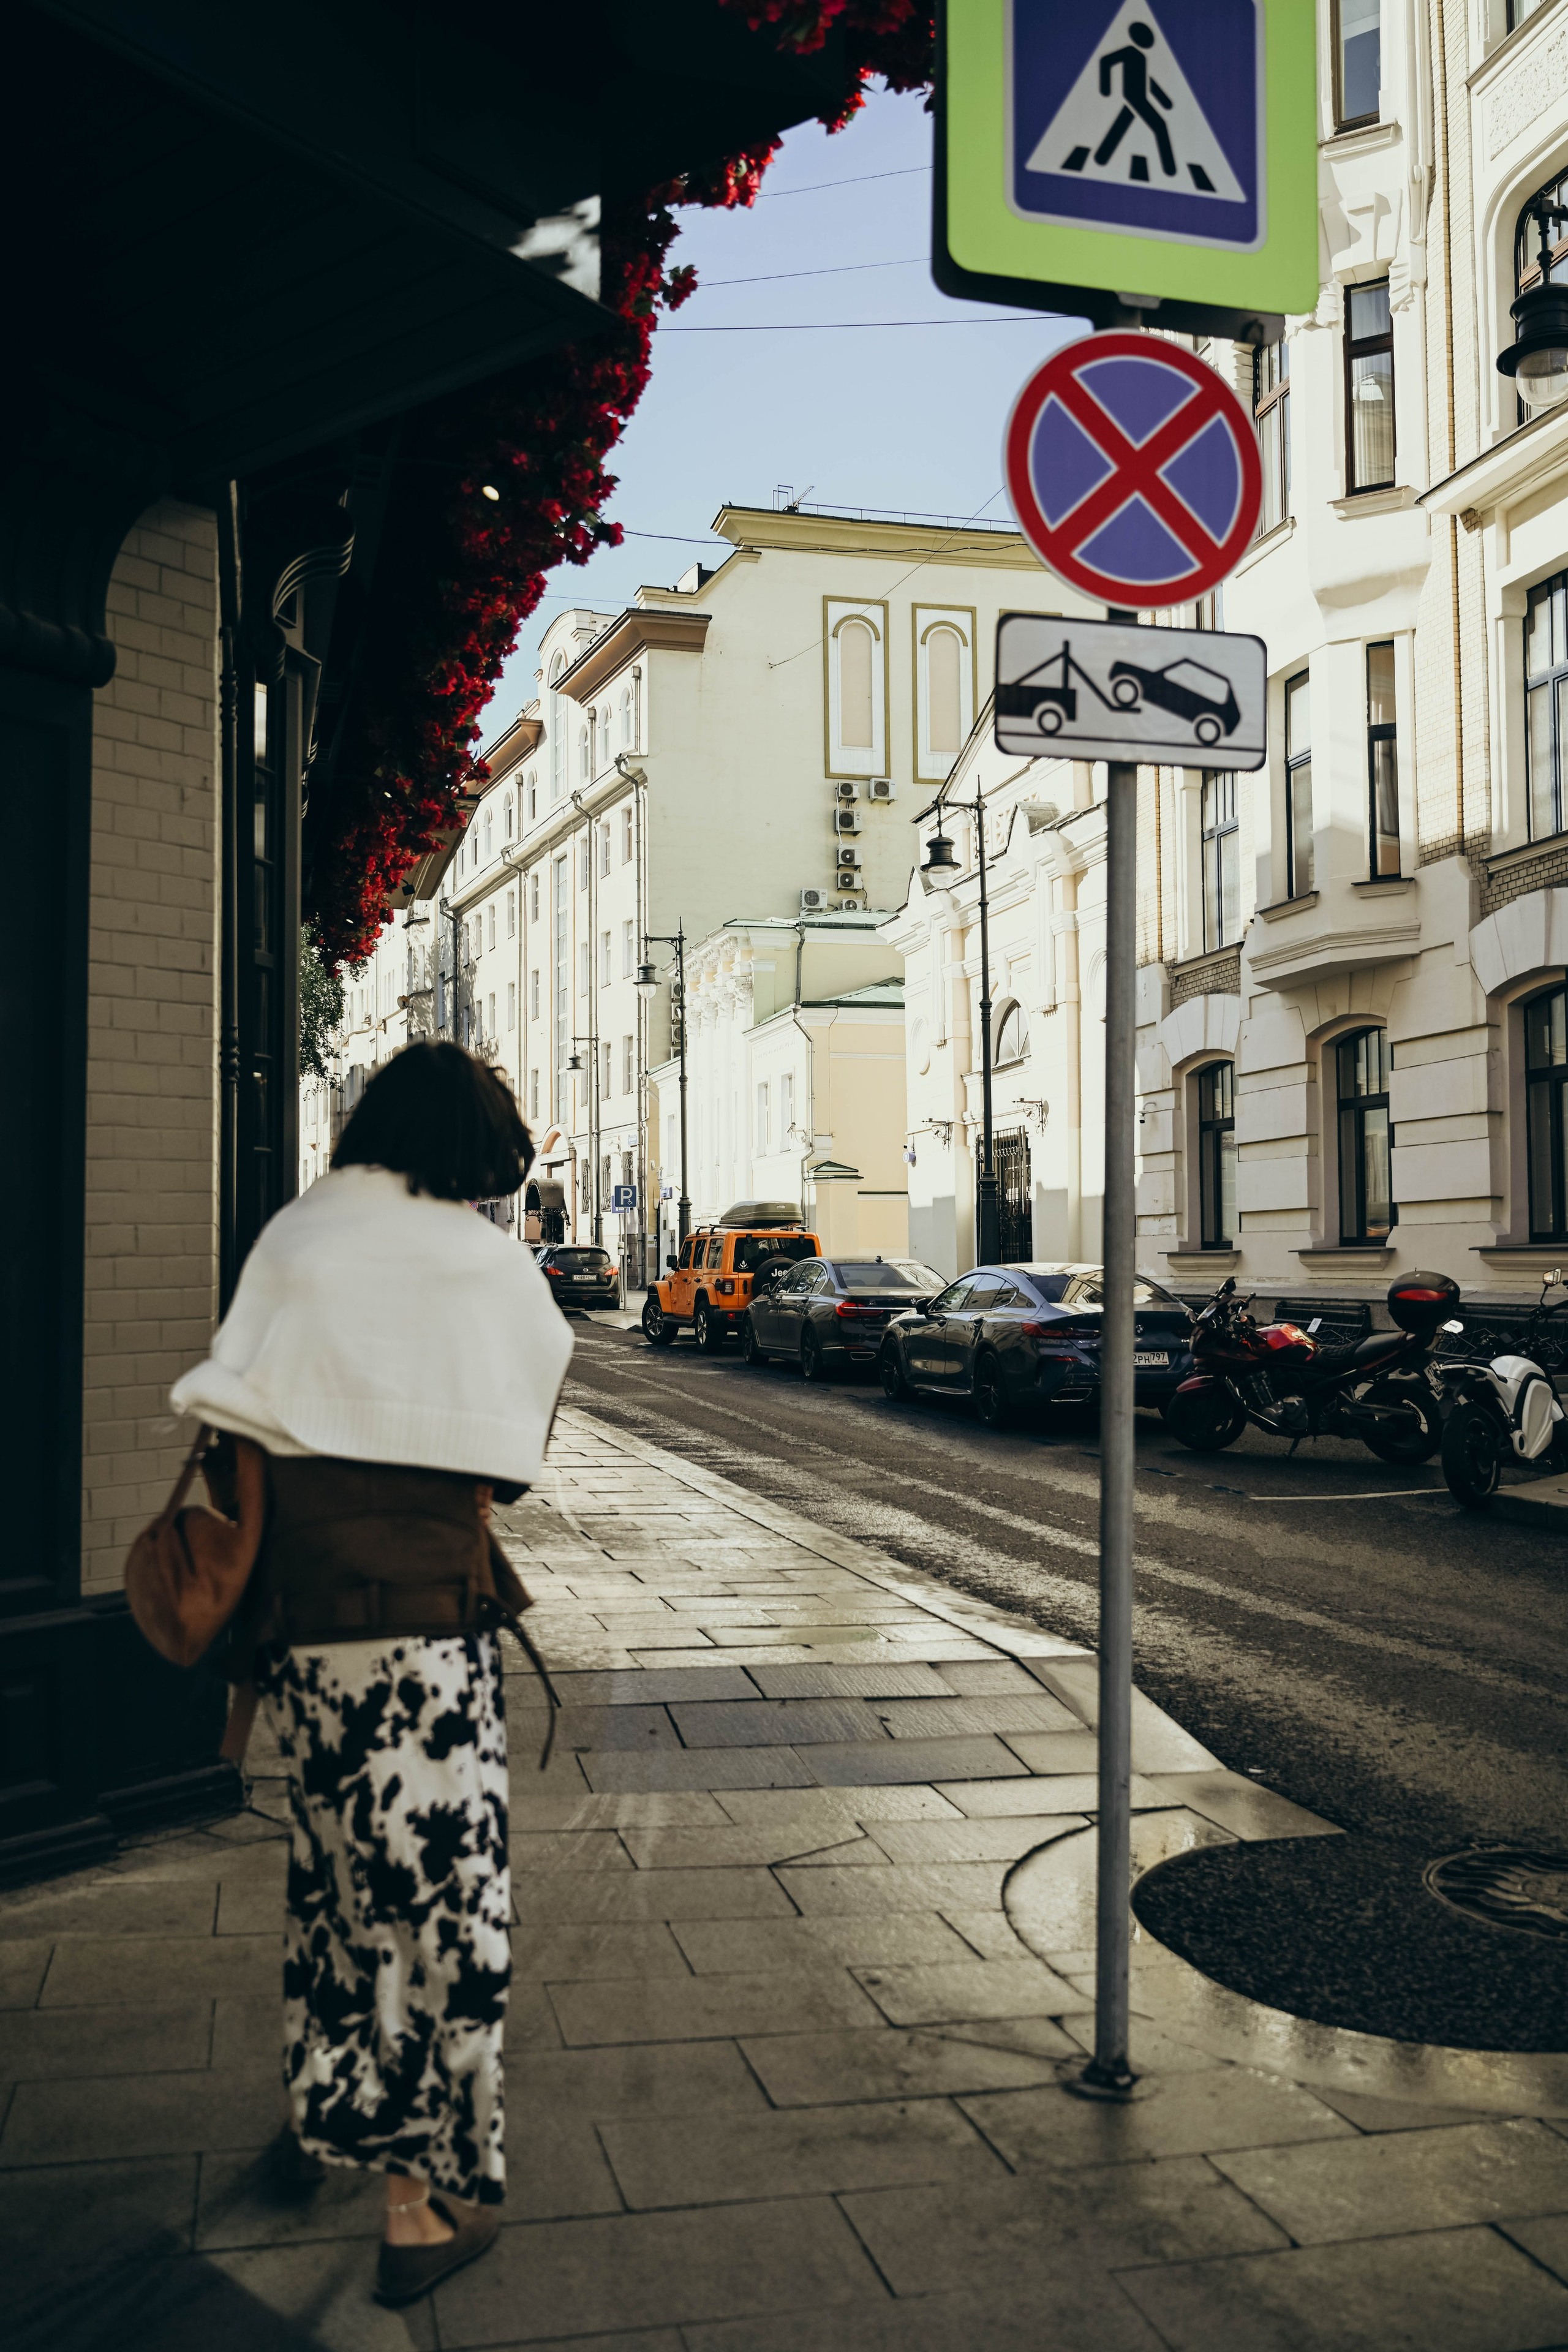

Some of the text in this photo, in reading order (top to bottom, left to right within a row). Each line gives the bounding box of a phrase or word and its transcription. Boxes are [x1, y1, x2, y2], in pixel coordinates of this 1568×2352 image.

[620, 1188, 633, 1205] P
[771, 1268, 788, 1277] Jee
[1133, 1354, 1150, 1363] 2РН
